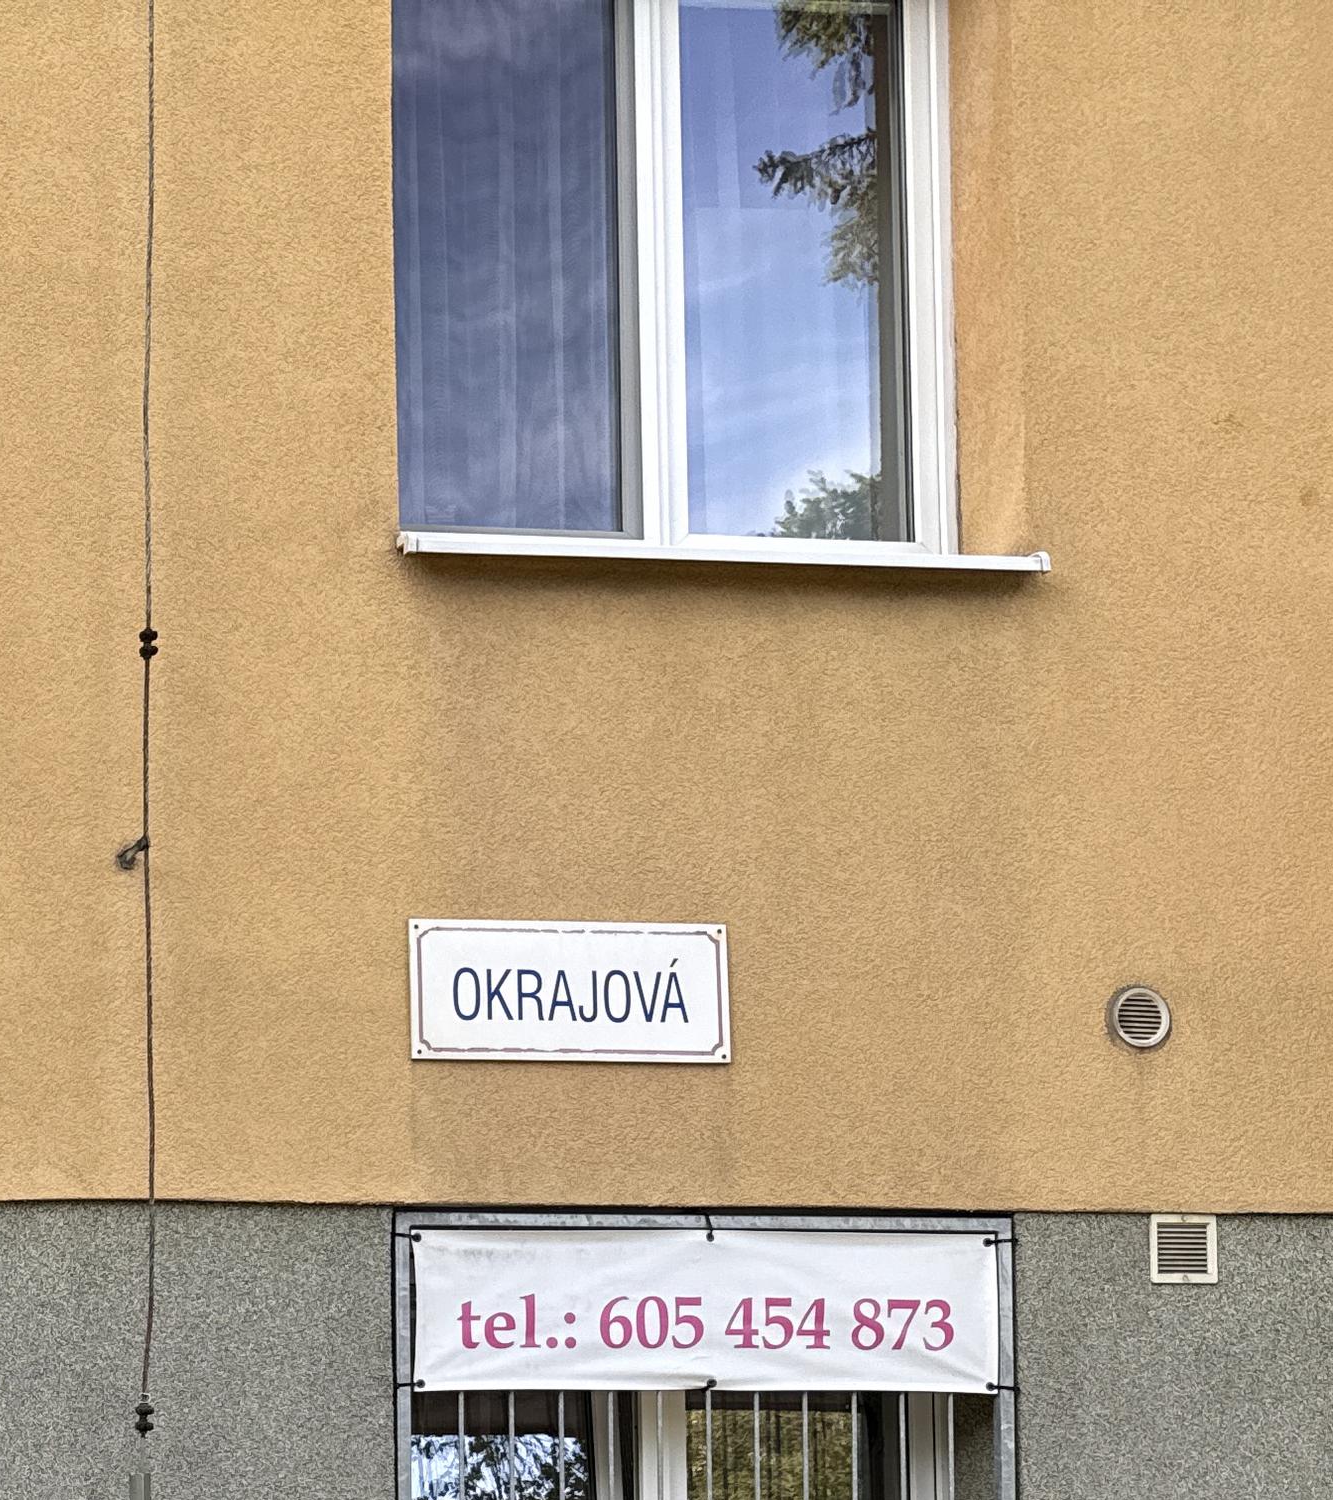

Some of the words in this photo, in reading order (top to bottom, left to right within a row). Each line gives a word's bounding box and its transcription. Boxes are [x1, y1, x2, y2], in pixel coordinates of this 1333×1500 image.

[452, 957, 689, 1025] OKRAJOVÁ
[457, 1293, 577, 1350] tel.:
[599, 1296, 705, 1350] 605
[724, 1297, 831, 1351] 454
[850, 1298, 955, 1352] 873
